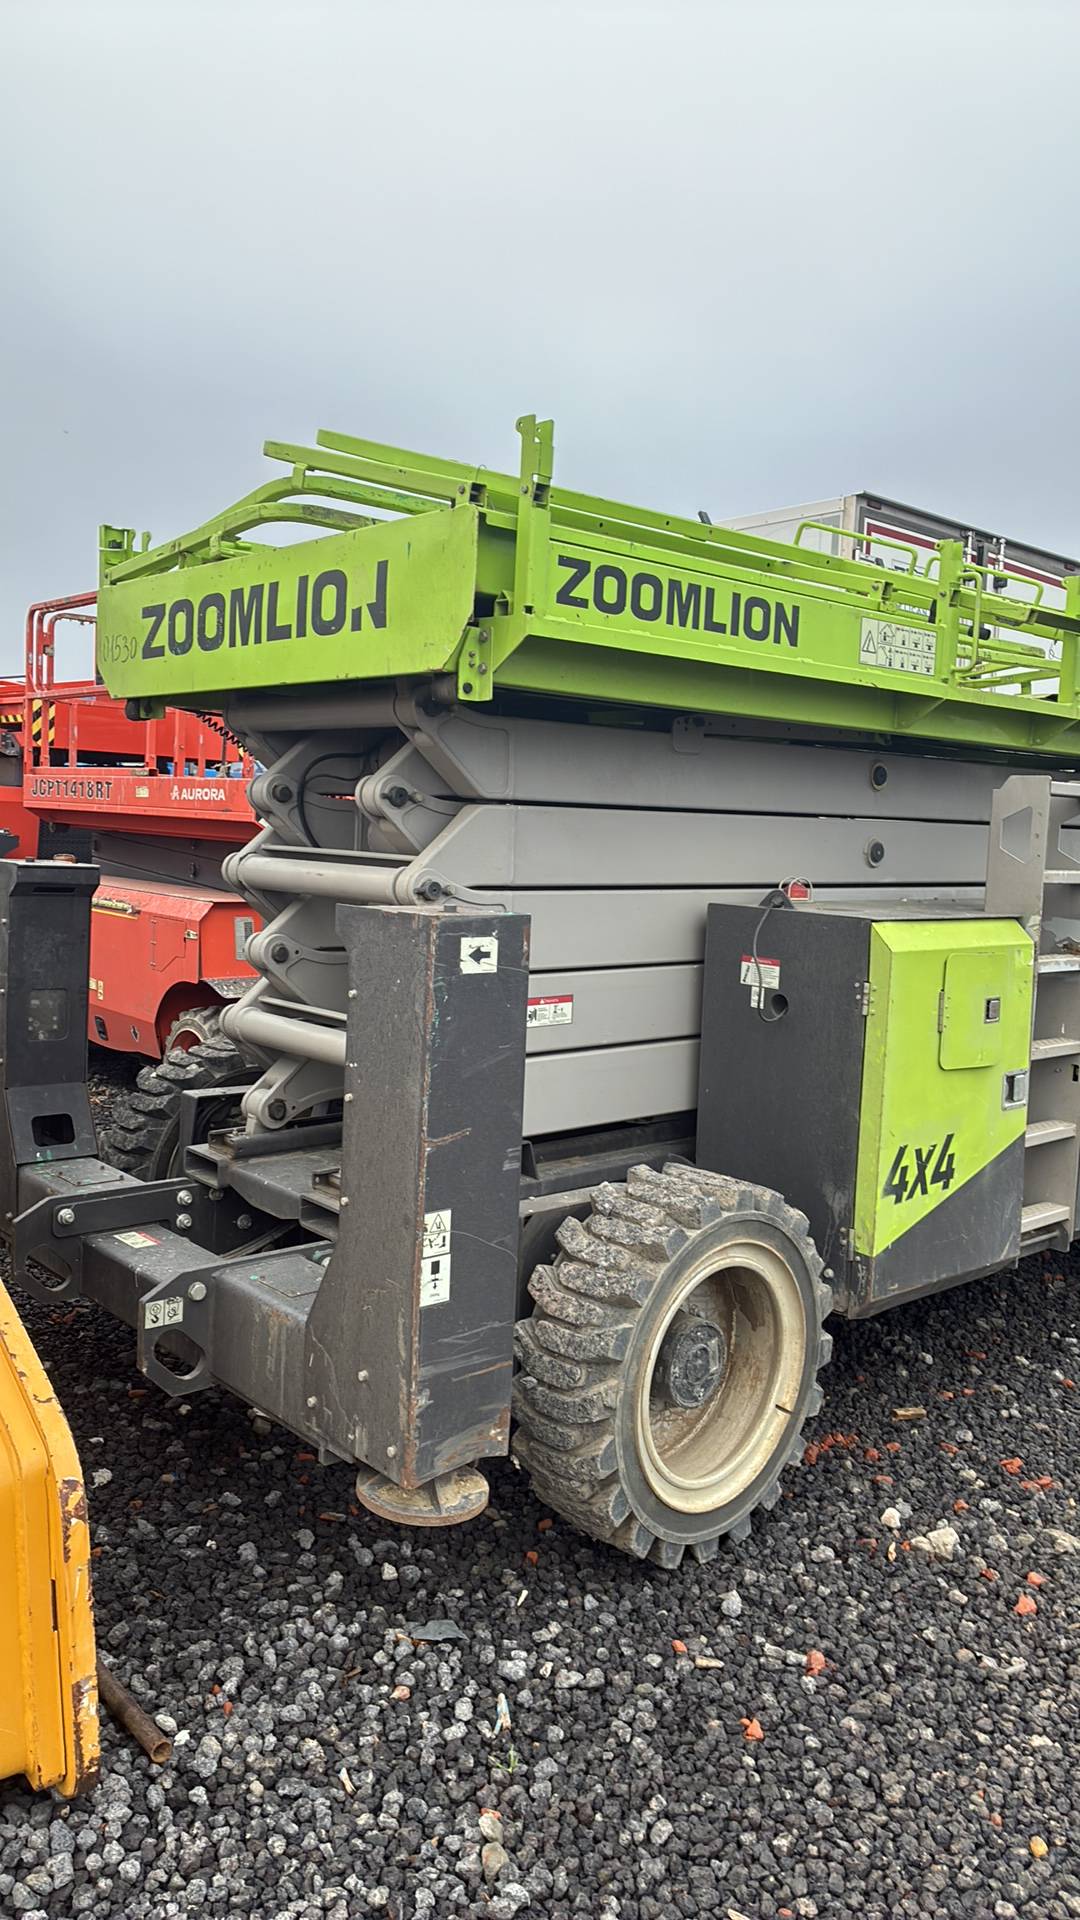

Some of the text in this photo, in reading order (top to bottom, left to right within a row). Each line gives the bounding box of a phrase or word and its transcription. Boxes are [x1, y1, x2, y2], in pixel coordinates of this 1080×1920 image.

[141, 559, 388, 659] ZOOMLION
[556, 554, 800, 648] ZOOMLION
[181, 788, 226, 801] AURORA
